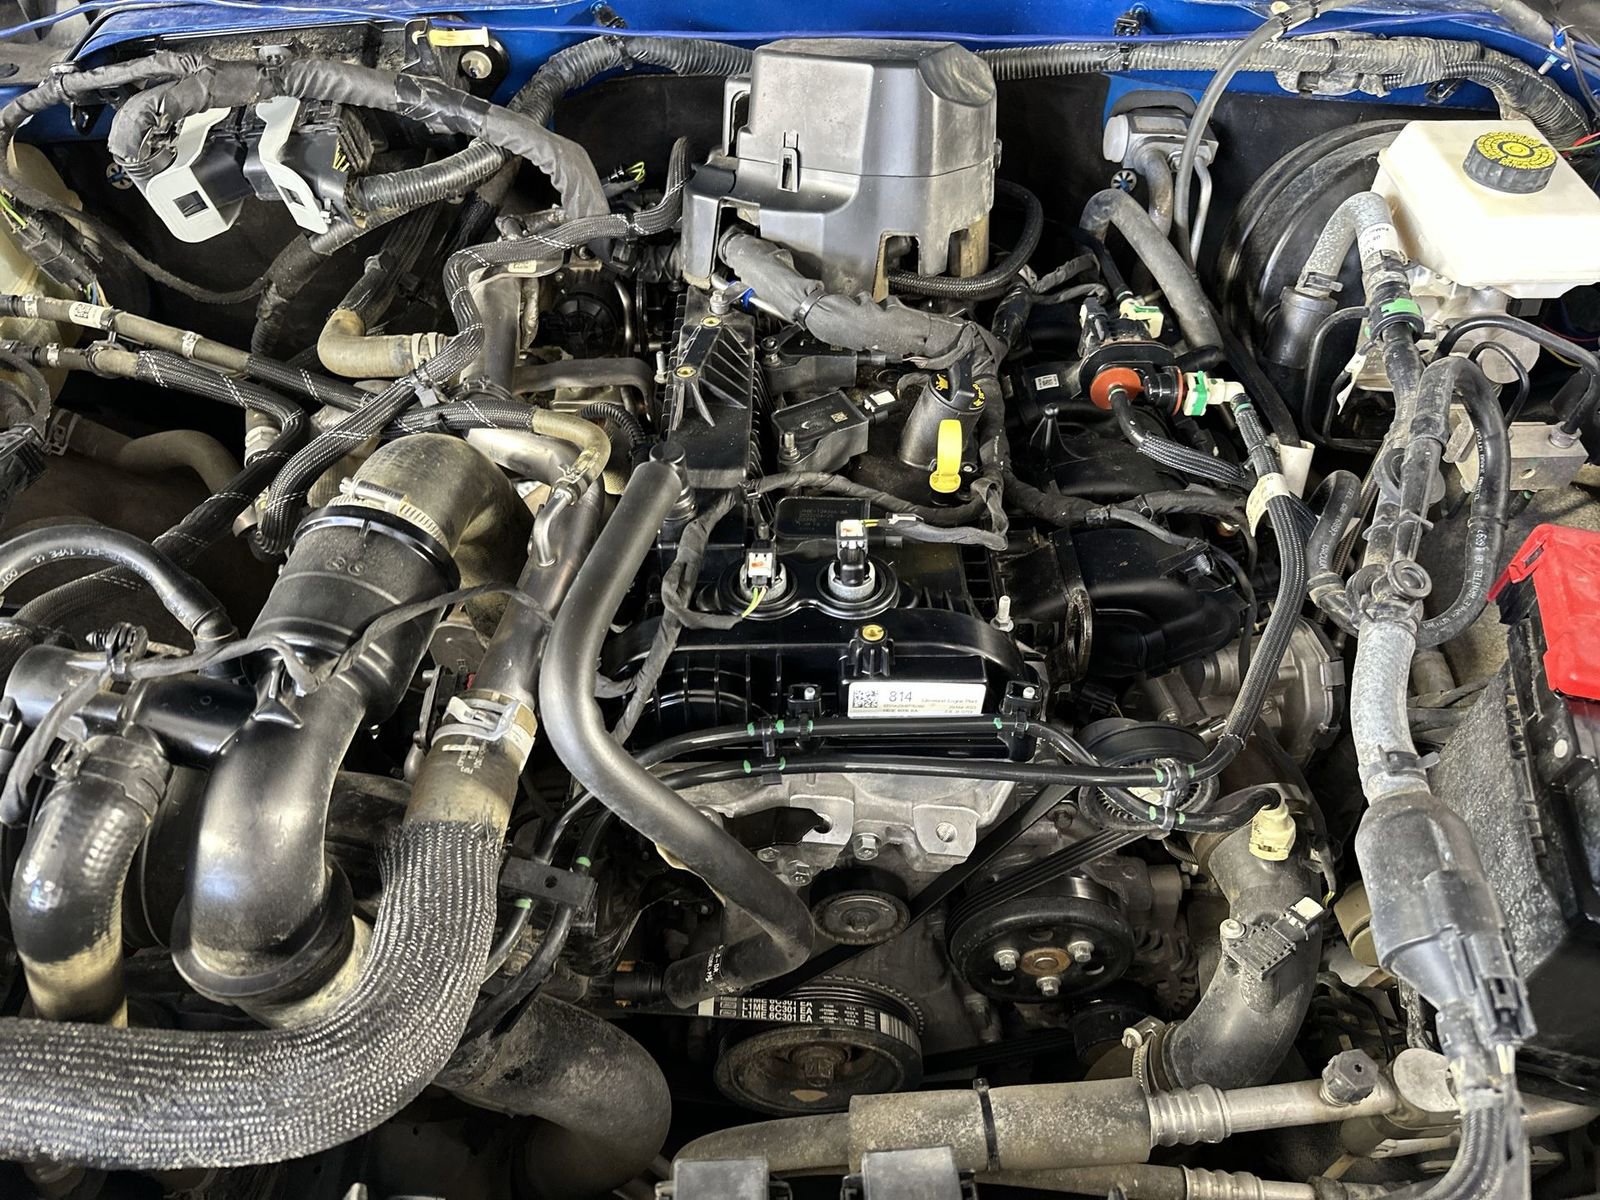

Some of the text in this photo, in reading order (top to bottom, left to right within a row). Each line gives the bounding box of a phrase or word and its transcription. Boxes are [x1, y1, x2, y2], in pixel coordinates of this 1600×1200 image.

[888, 690, 912, 702] 814
[742, 1002, 767, 1012] L1ME
[769, 1004, 796, 1014] 6C301
[800, 1006, 812, 1015] EA
[742, 1010, 812, 1023] L1ME 6C301 EA
